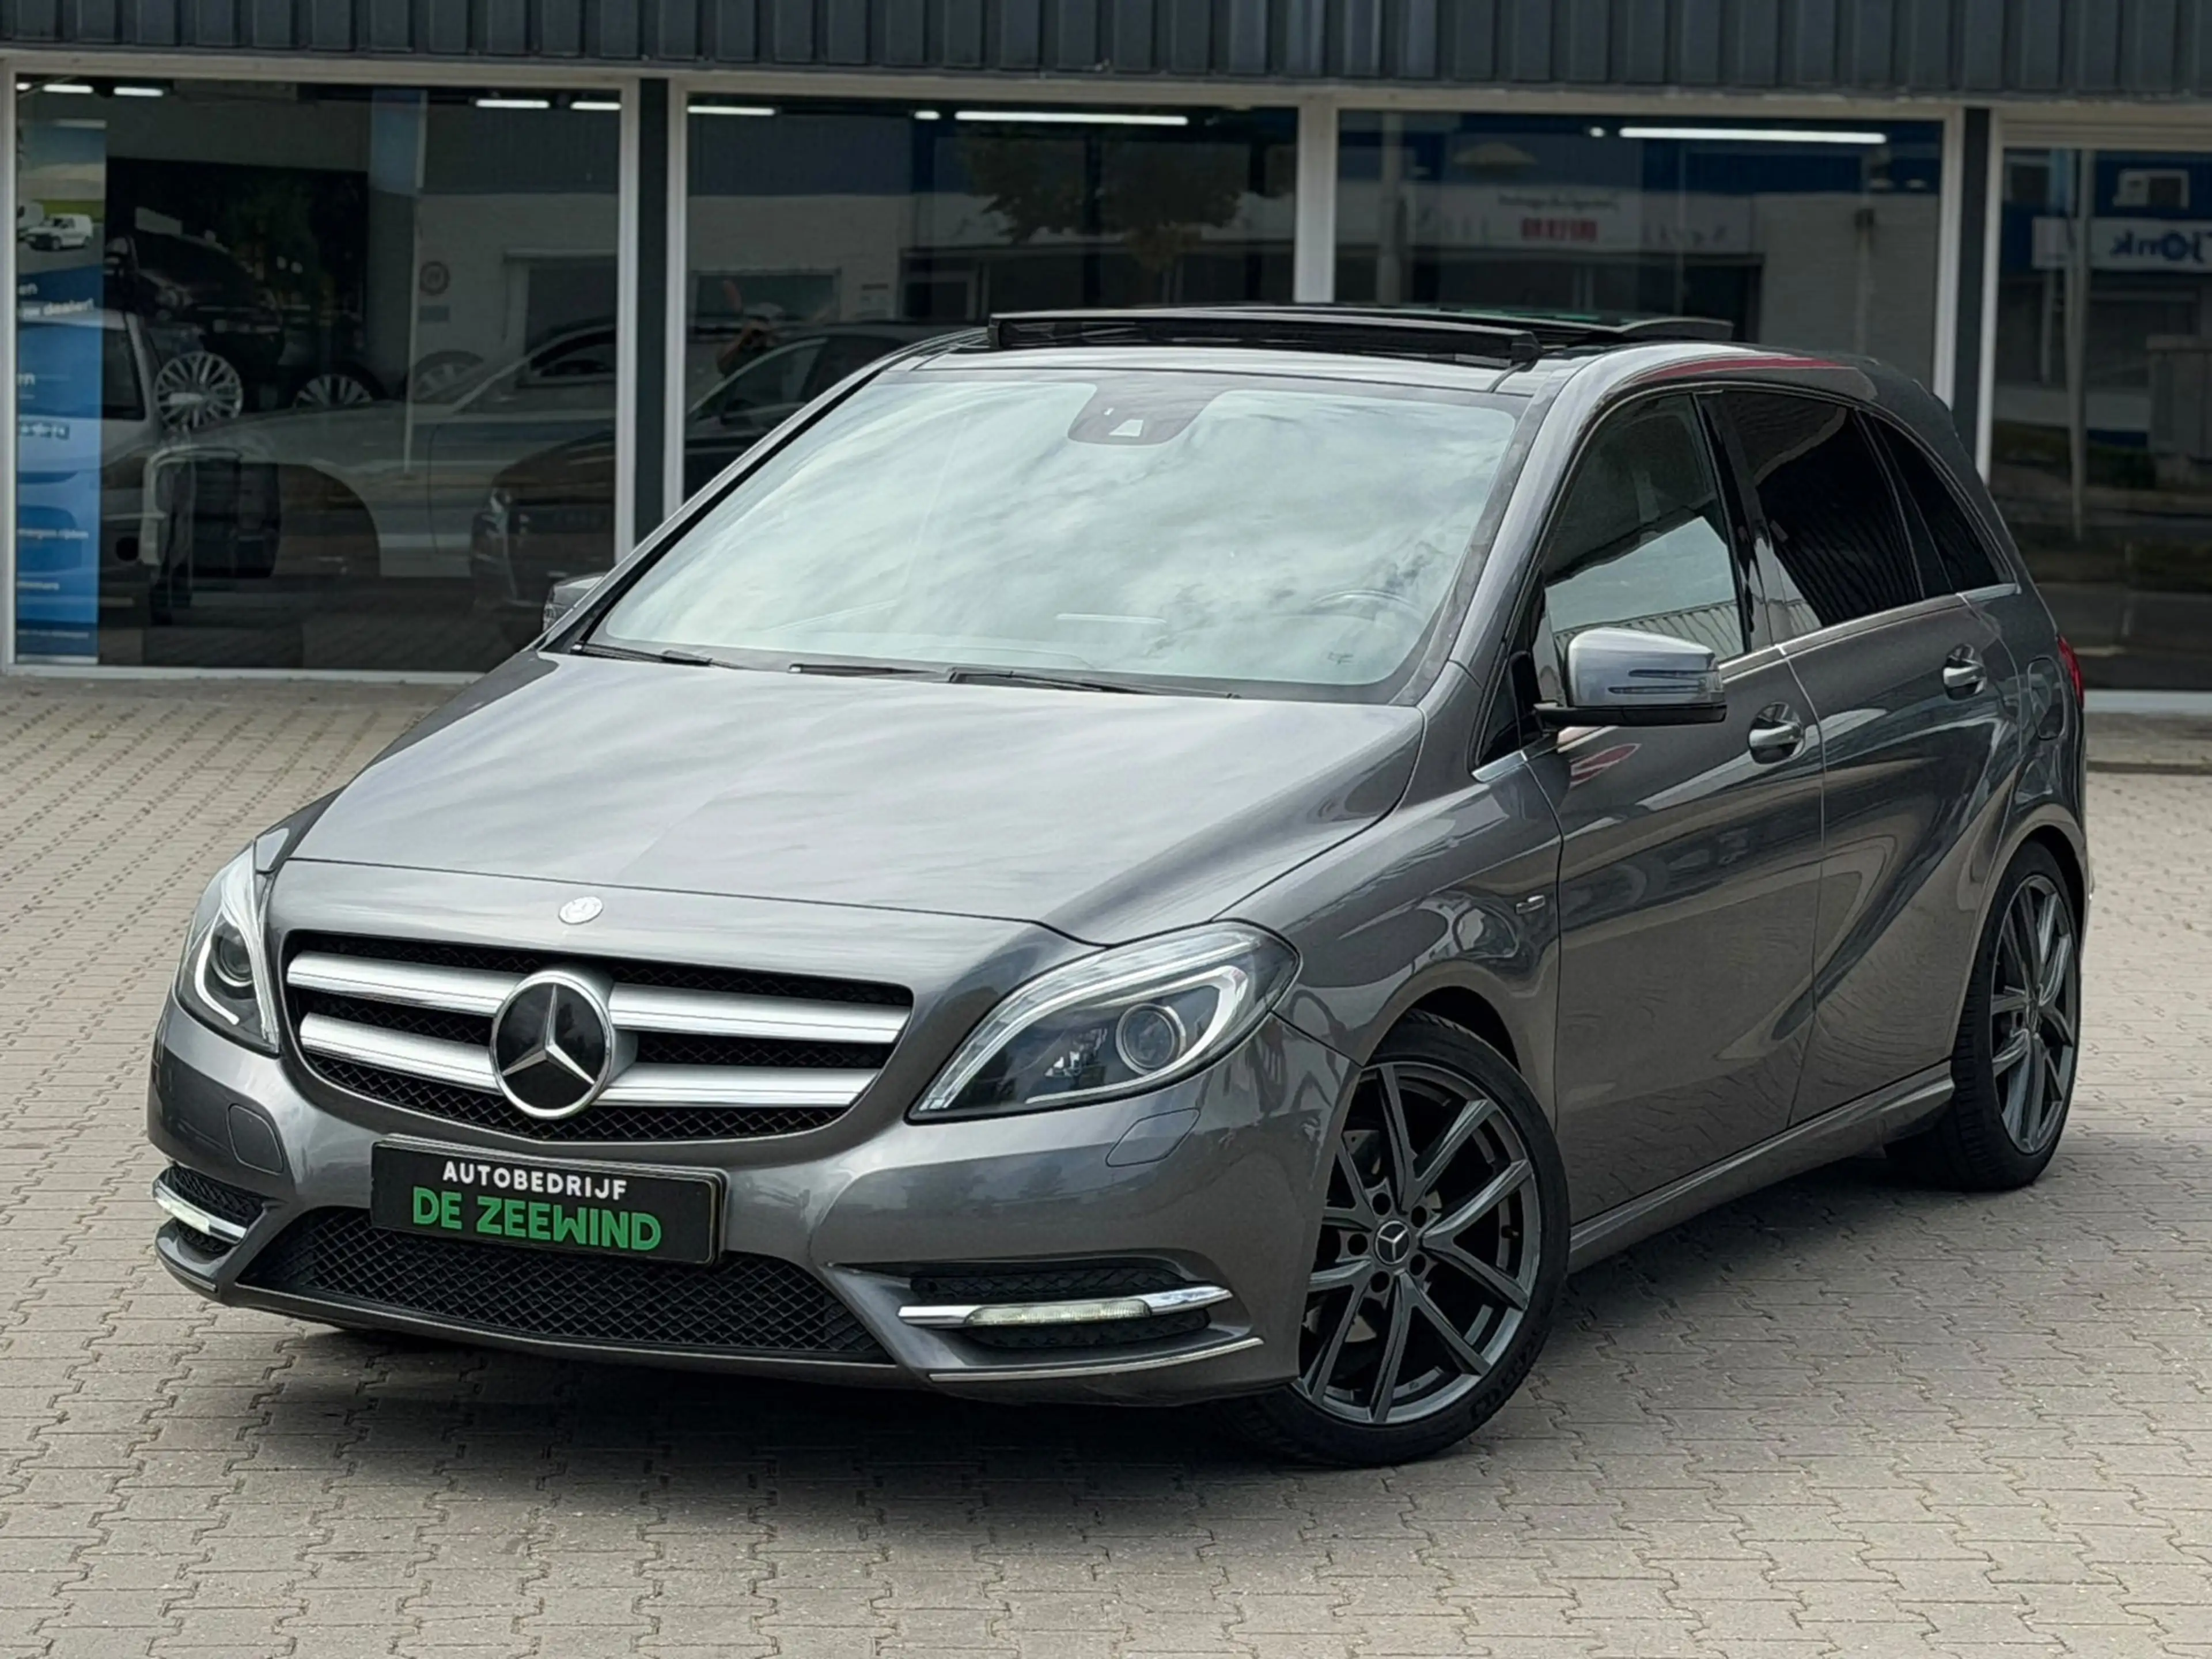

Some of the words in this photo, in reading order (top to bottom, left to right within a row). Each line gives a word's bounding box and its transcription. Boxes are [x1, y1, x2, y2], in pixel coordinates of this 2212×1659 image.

[442, 1161, 627, 1200] AUTOBEDRIJF
[412, 1186, 463, 1230] DE
[476, 1195, 662, 1251] ZEEWIND
